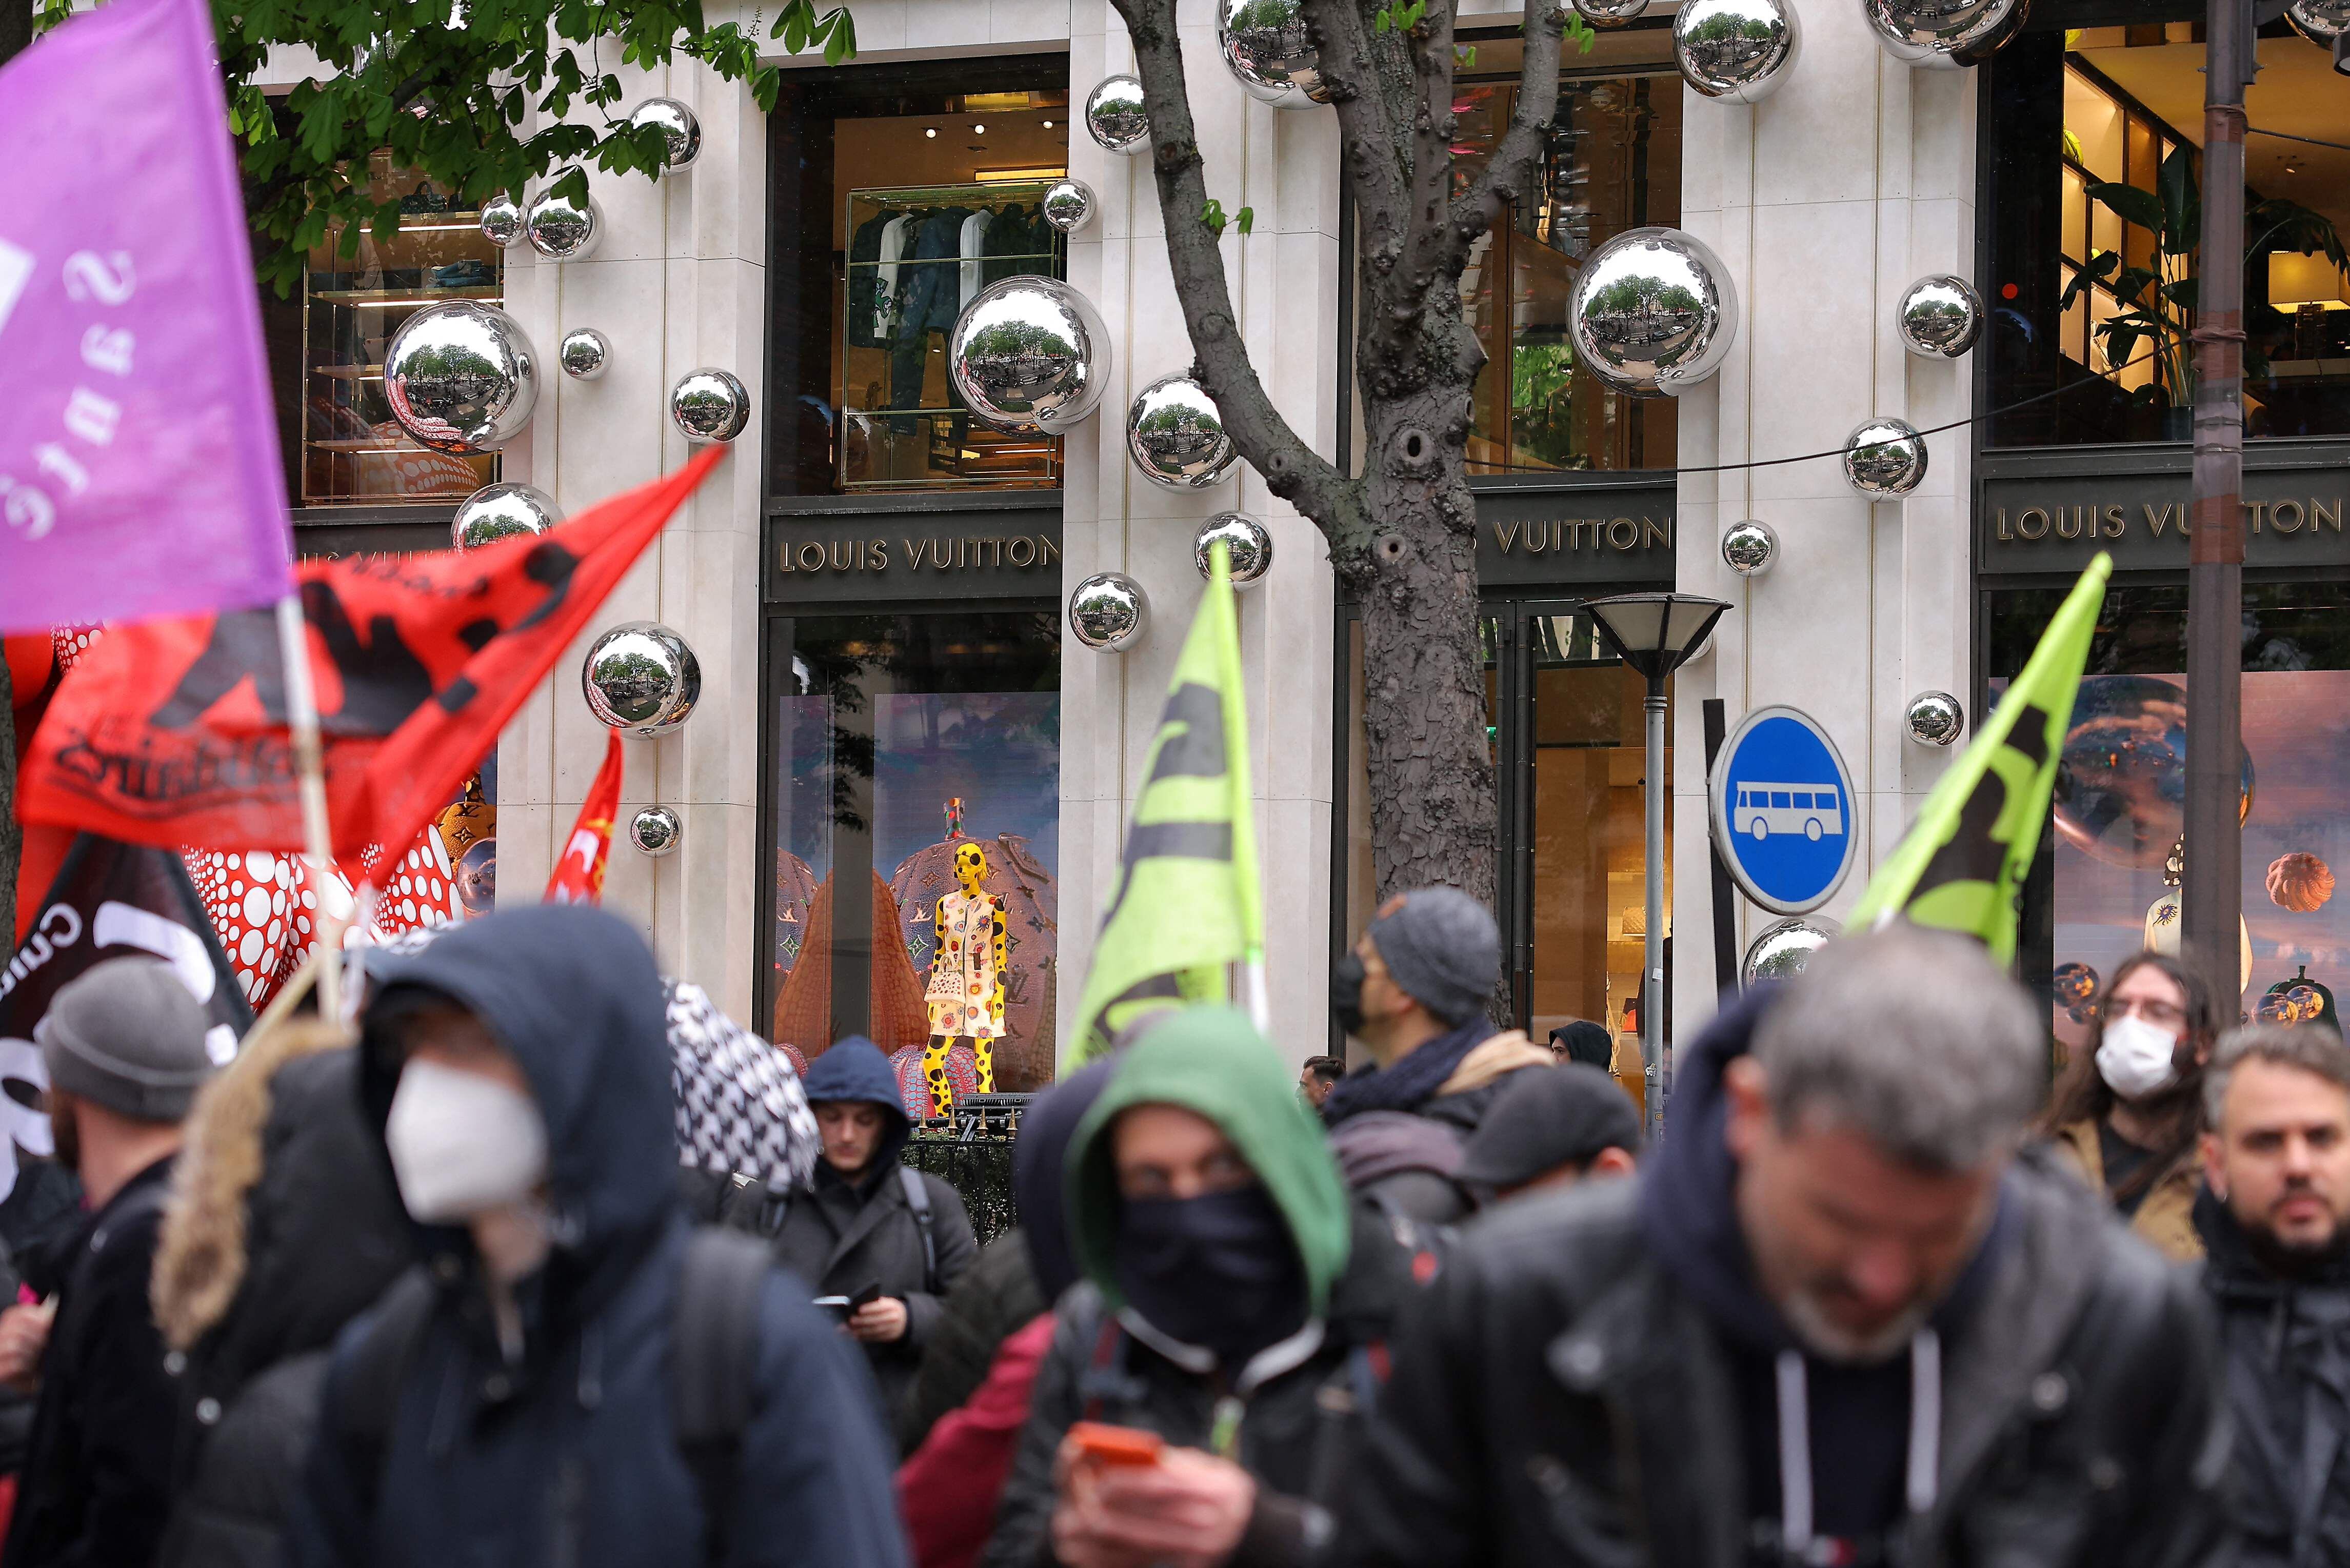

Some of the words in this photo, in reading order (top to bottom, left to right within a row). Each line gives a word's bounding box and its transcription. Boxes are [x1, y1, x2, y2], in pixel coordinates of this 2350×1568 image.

[1492, 516, 1671, 553] VUITTON
[1997, 504, 2124, 540] LOUIS
[2143, 498, 2341, 537] VUTON
[780, 539, 888, 571] LOUIS
[903, 534, 1062, 570] VUITTON
